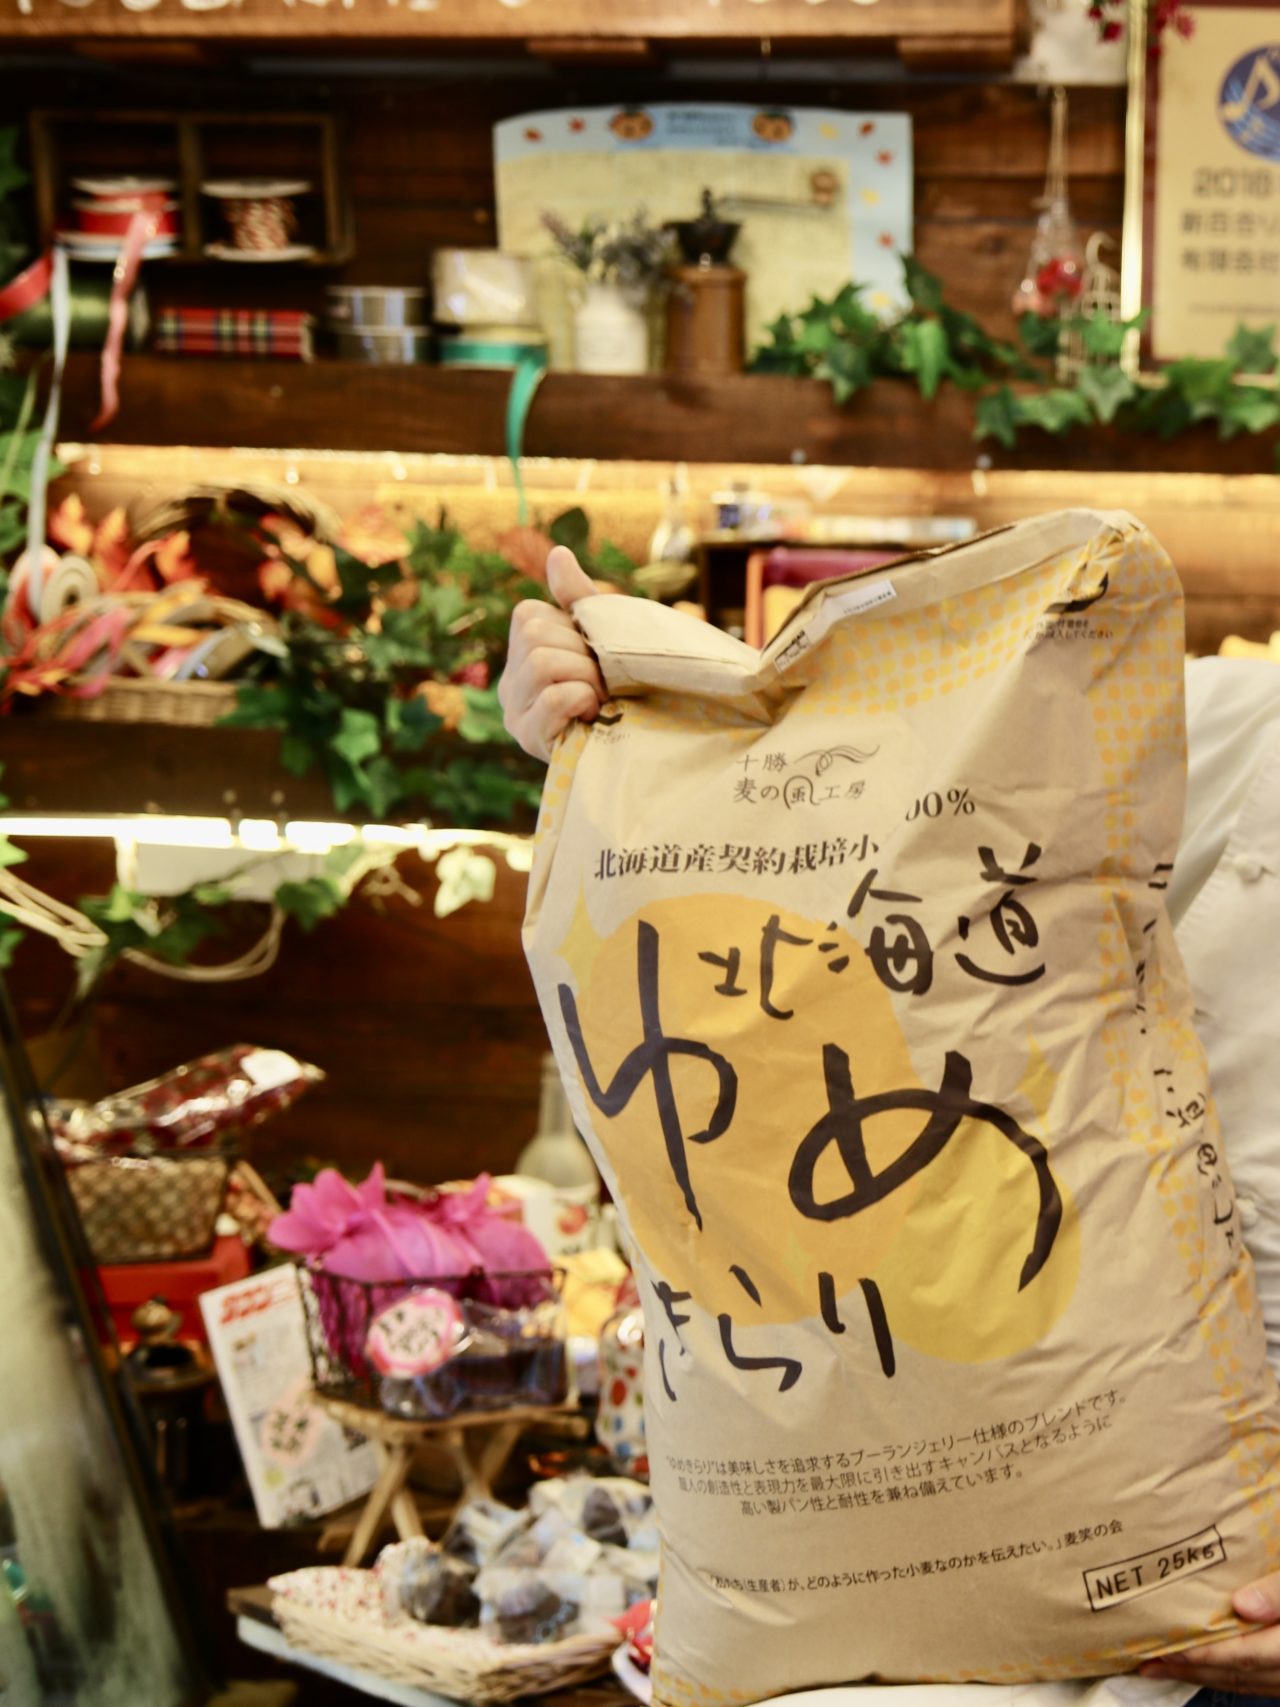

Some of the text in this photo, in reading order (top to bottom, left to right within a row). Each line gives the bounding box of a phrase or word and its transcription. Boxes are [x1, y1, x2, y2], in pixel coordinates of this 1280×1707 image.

[736, 751, 788, 773] 十勝
[697, 842, 1046, 1021] 北海道
[557, 919, 1064, 1293] ゆめ
[649, 1263, 896, 1403] きらり
[1096, 1564, 1143, 1600] NET
